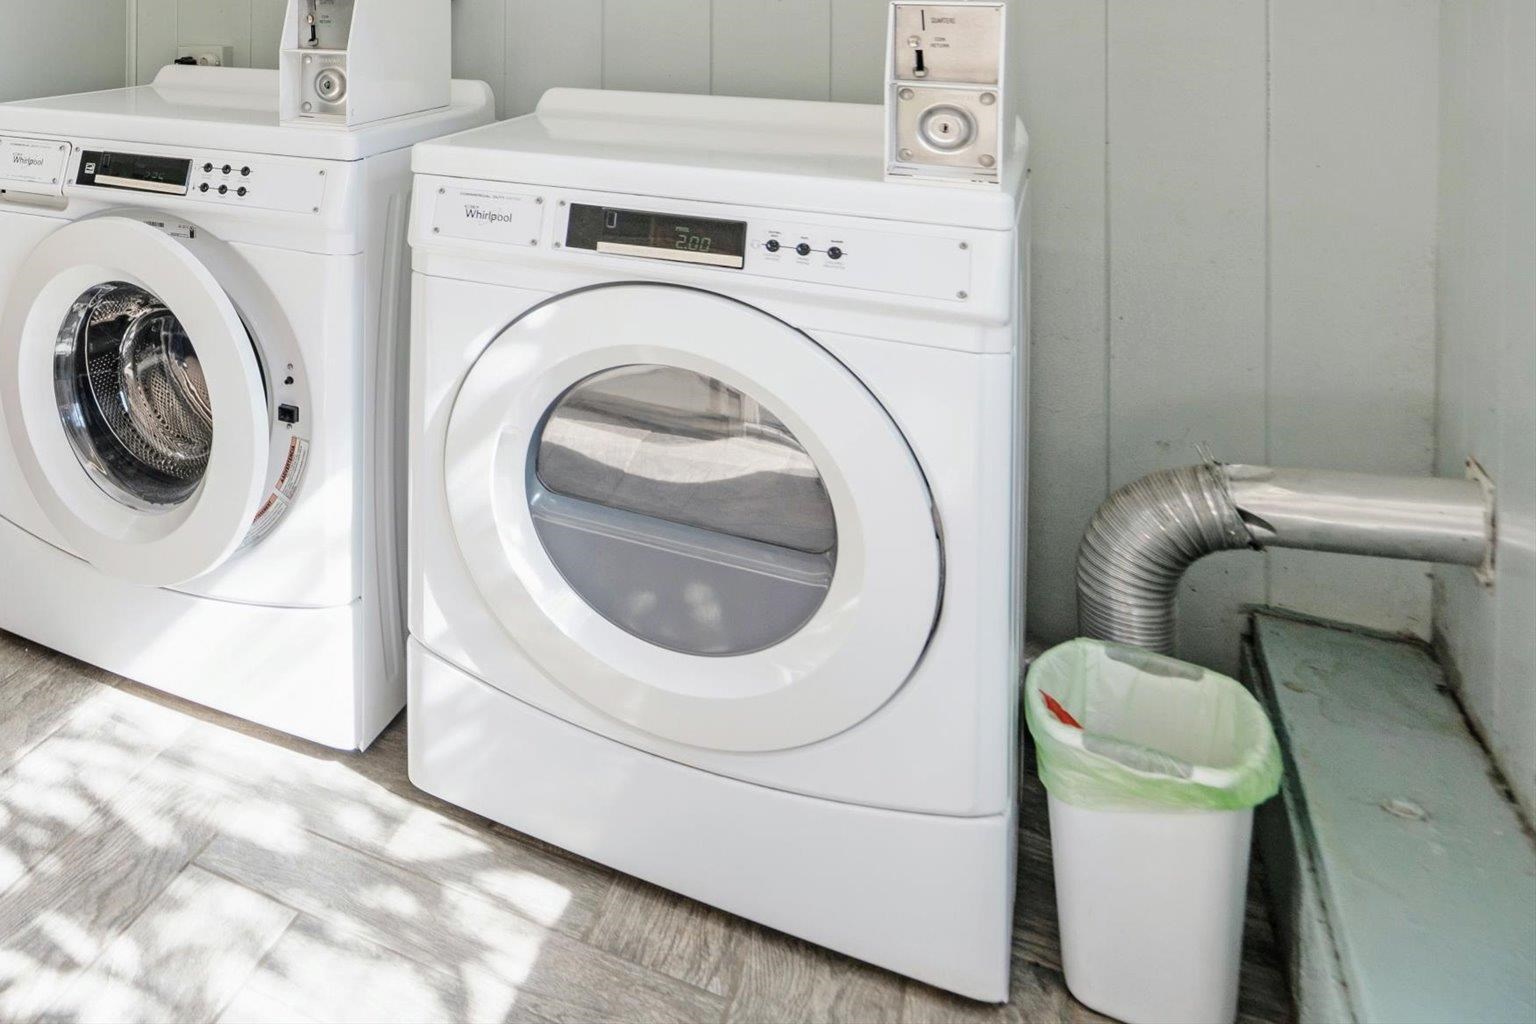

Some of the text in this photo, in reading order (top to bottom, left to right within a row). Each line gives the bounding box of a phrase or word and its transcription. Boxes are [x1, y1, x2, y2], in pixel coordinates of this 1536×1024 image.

[13, 156, 44, 166] Whirlpool
[465, 209, 512, 223] Whirlpool
[675, 234, 711, 253] 2.00
